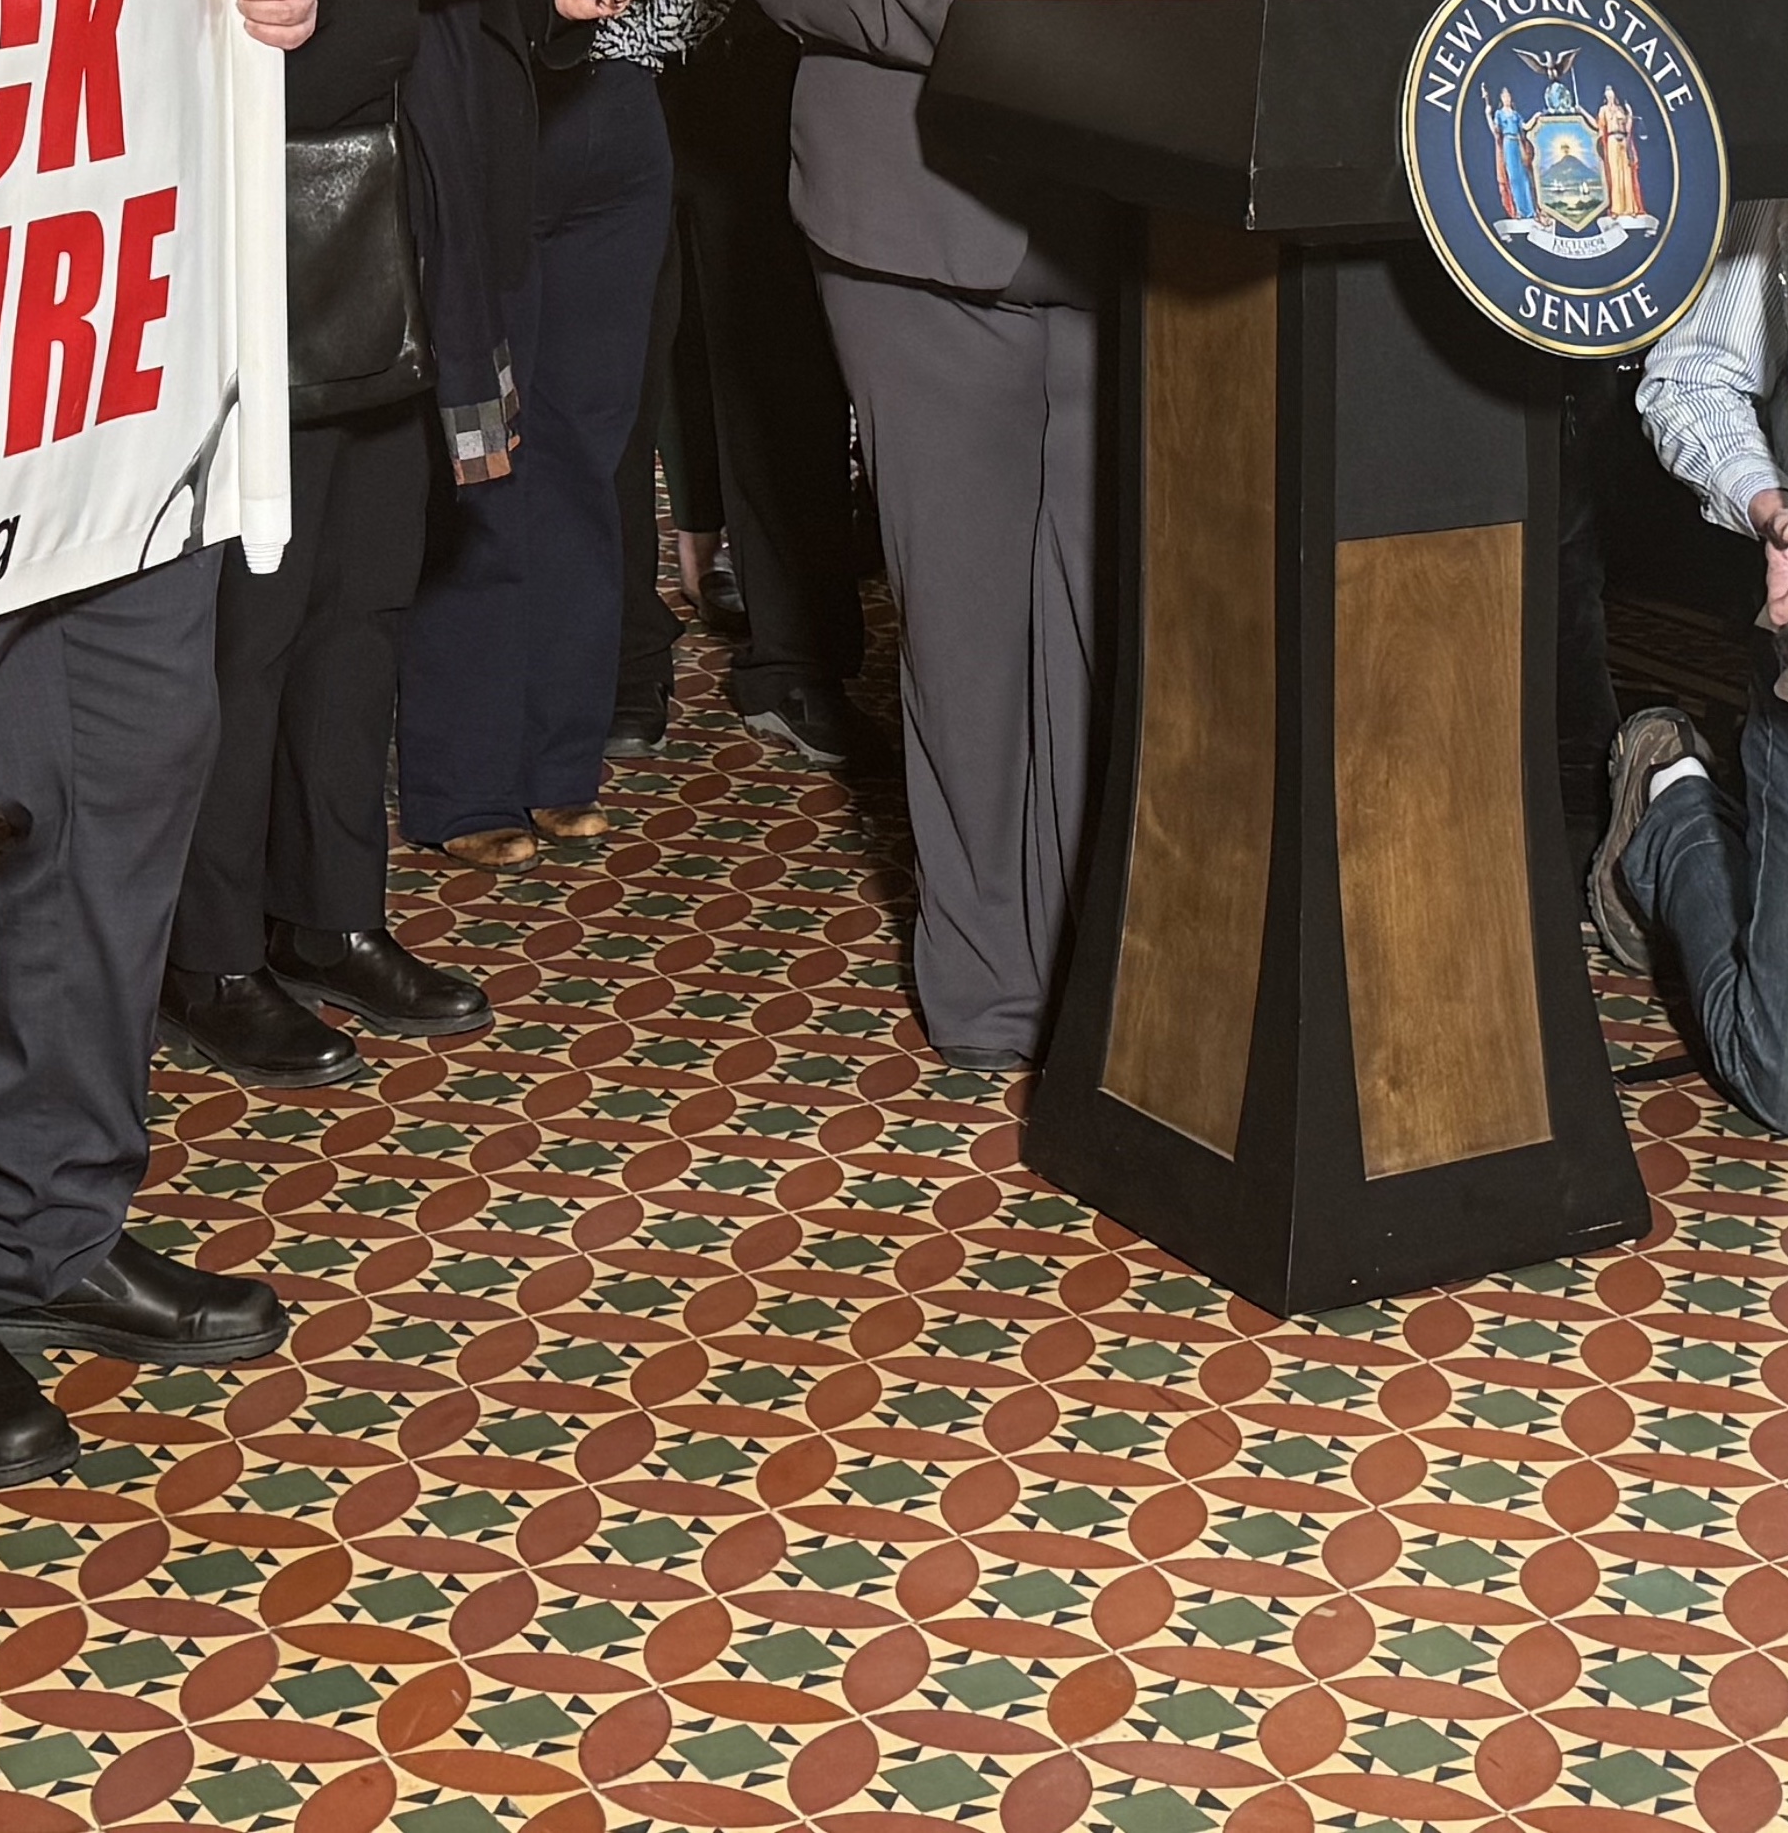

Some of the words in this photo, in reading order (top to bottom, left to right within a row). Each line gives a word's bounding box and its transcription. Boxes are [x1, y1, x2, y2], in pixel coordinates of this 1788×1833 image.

[1425, 9, 1481, 113] NEW
[1599, 0, 1694, 112] STATE
[1519, 282, 1659, 336] SENATE
